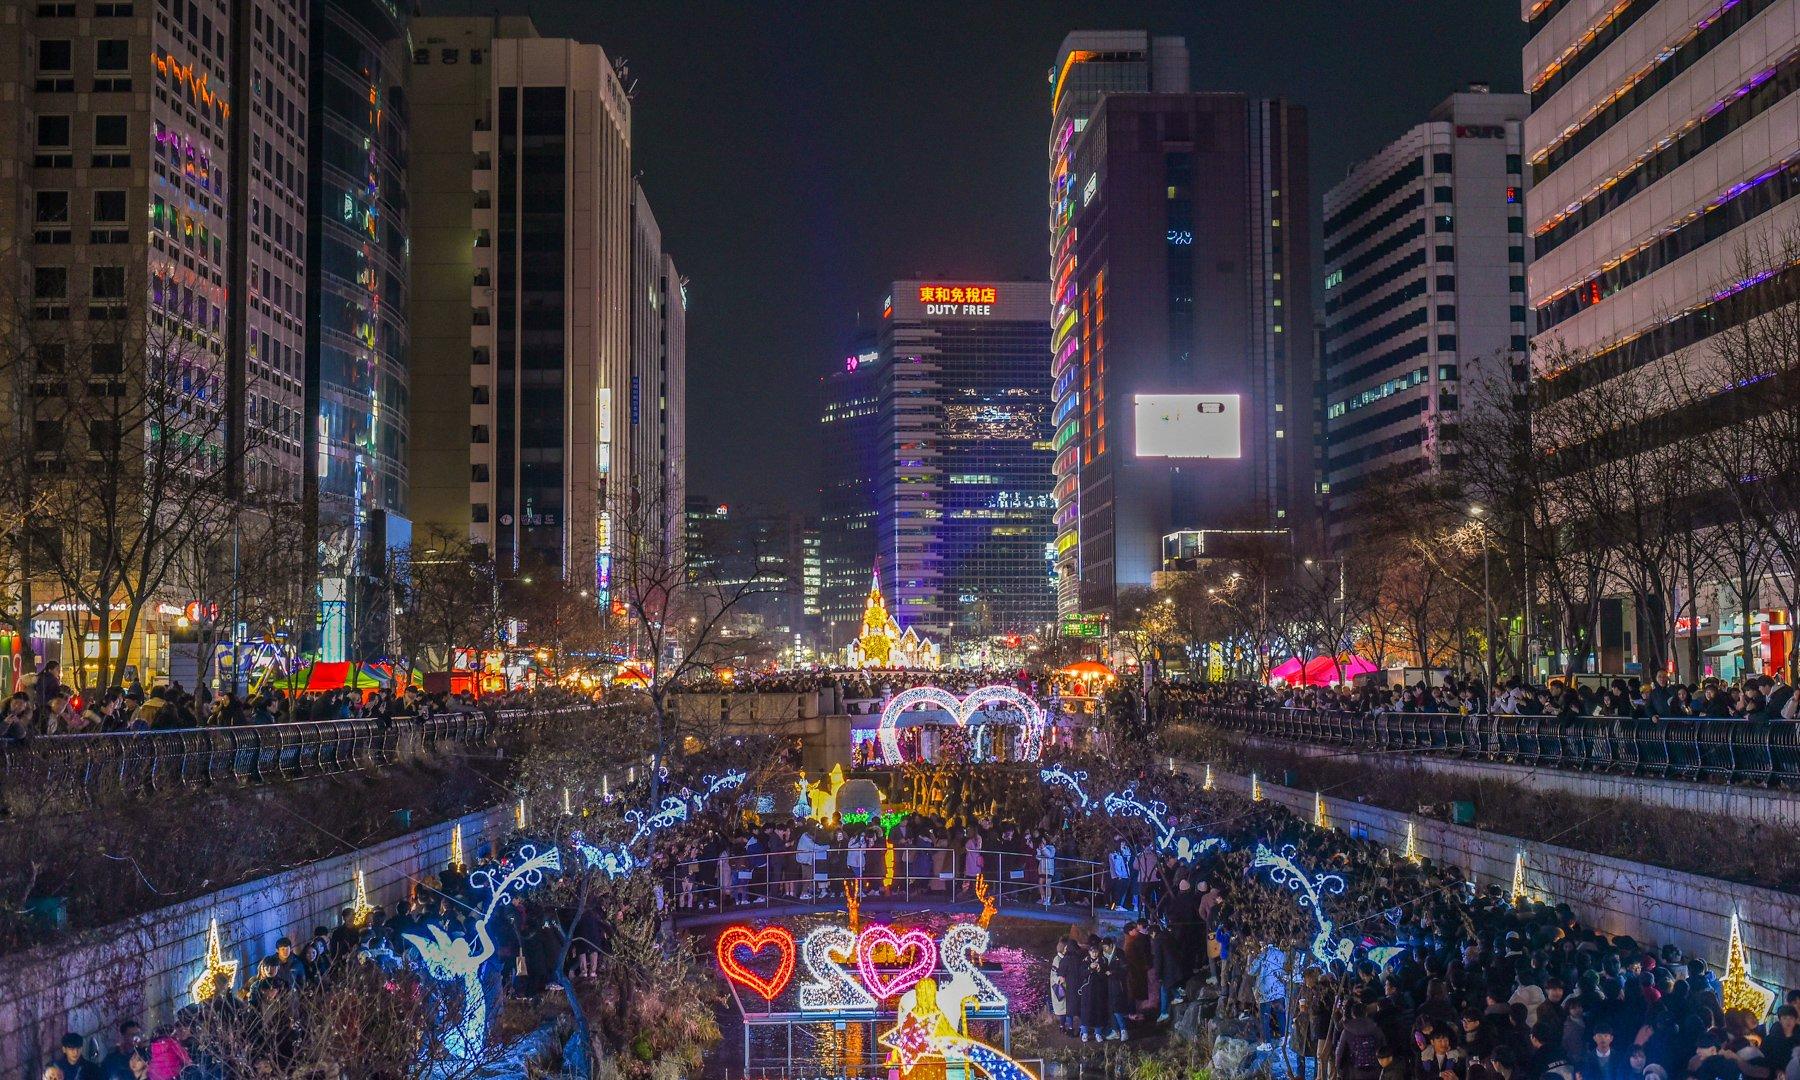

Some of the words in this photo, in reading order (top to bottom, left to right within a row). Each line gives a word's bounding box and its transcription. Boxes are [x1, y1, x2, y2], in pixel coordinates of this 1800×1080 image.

[927, 304, 957, 315] DUTY
[962, 305, 990, 316] FREE
[35, 619, 60, 639] STAGE
